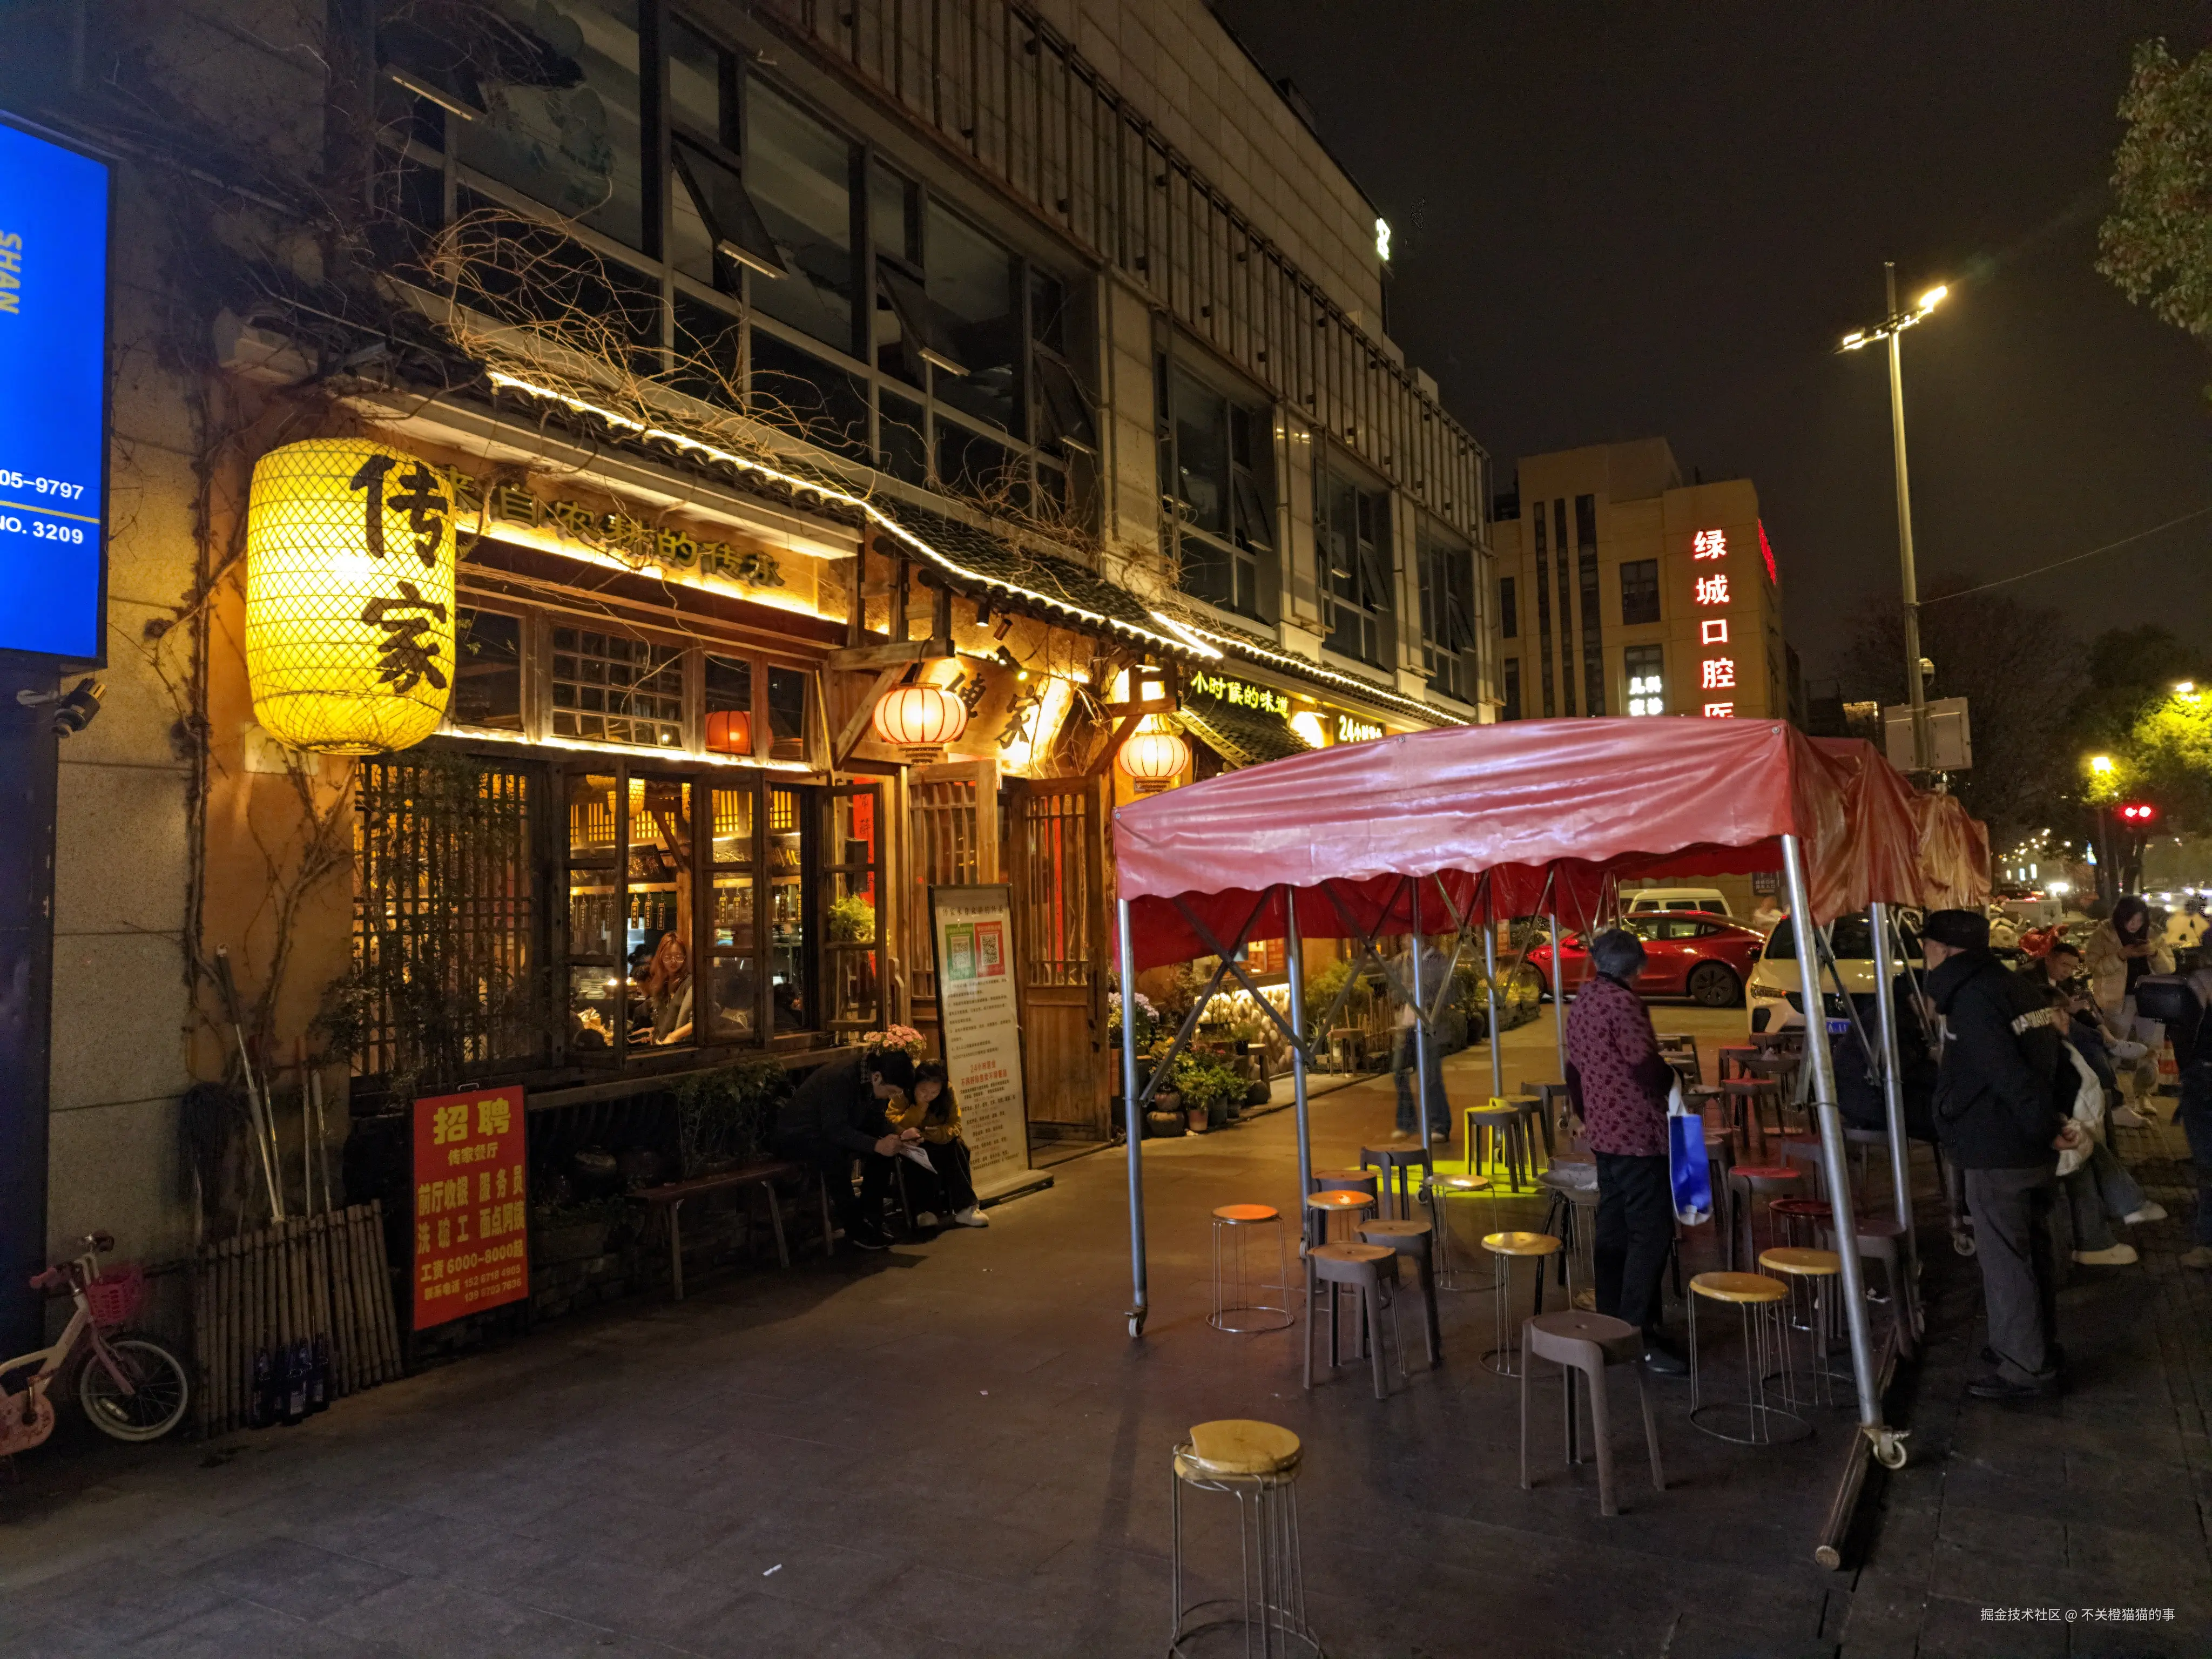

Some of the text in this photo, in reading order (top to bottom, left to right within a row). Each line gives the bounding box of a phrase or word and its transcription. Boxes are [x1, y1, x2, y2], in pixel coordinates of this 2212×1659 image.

[0, 230, 22, 314] SHAN
[32, 521, 83, 544] 3209
[451, 464, 785, 586] 来自农耕的传承
[350, 454, 448, 694] 传家
[1190, 670, 1289, 719] 小时候的味道
[434, 1097, 511, 1145] 招聘
[448, 1141, 498, 1166] 传家餐厅
[418, 1164, 523, 1216] 前厅收银 服务员
[421, 1259, 444, 1282] 工资
[424, 1279, 460, 1300] 联系电话
